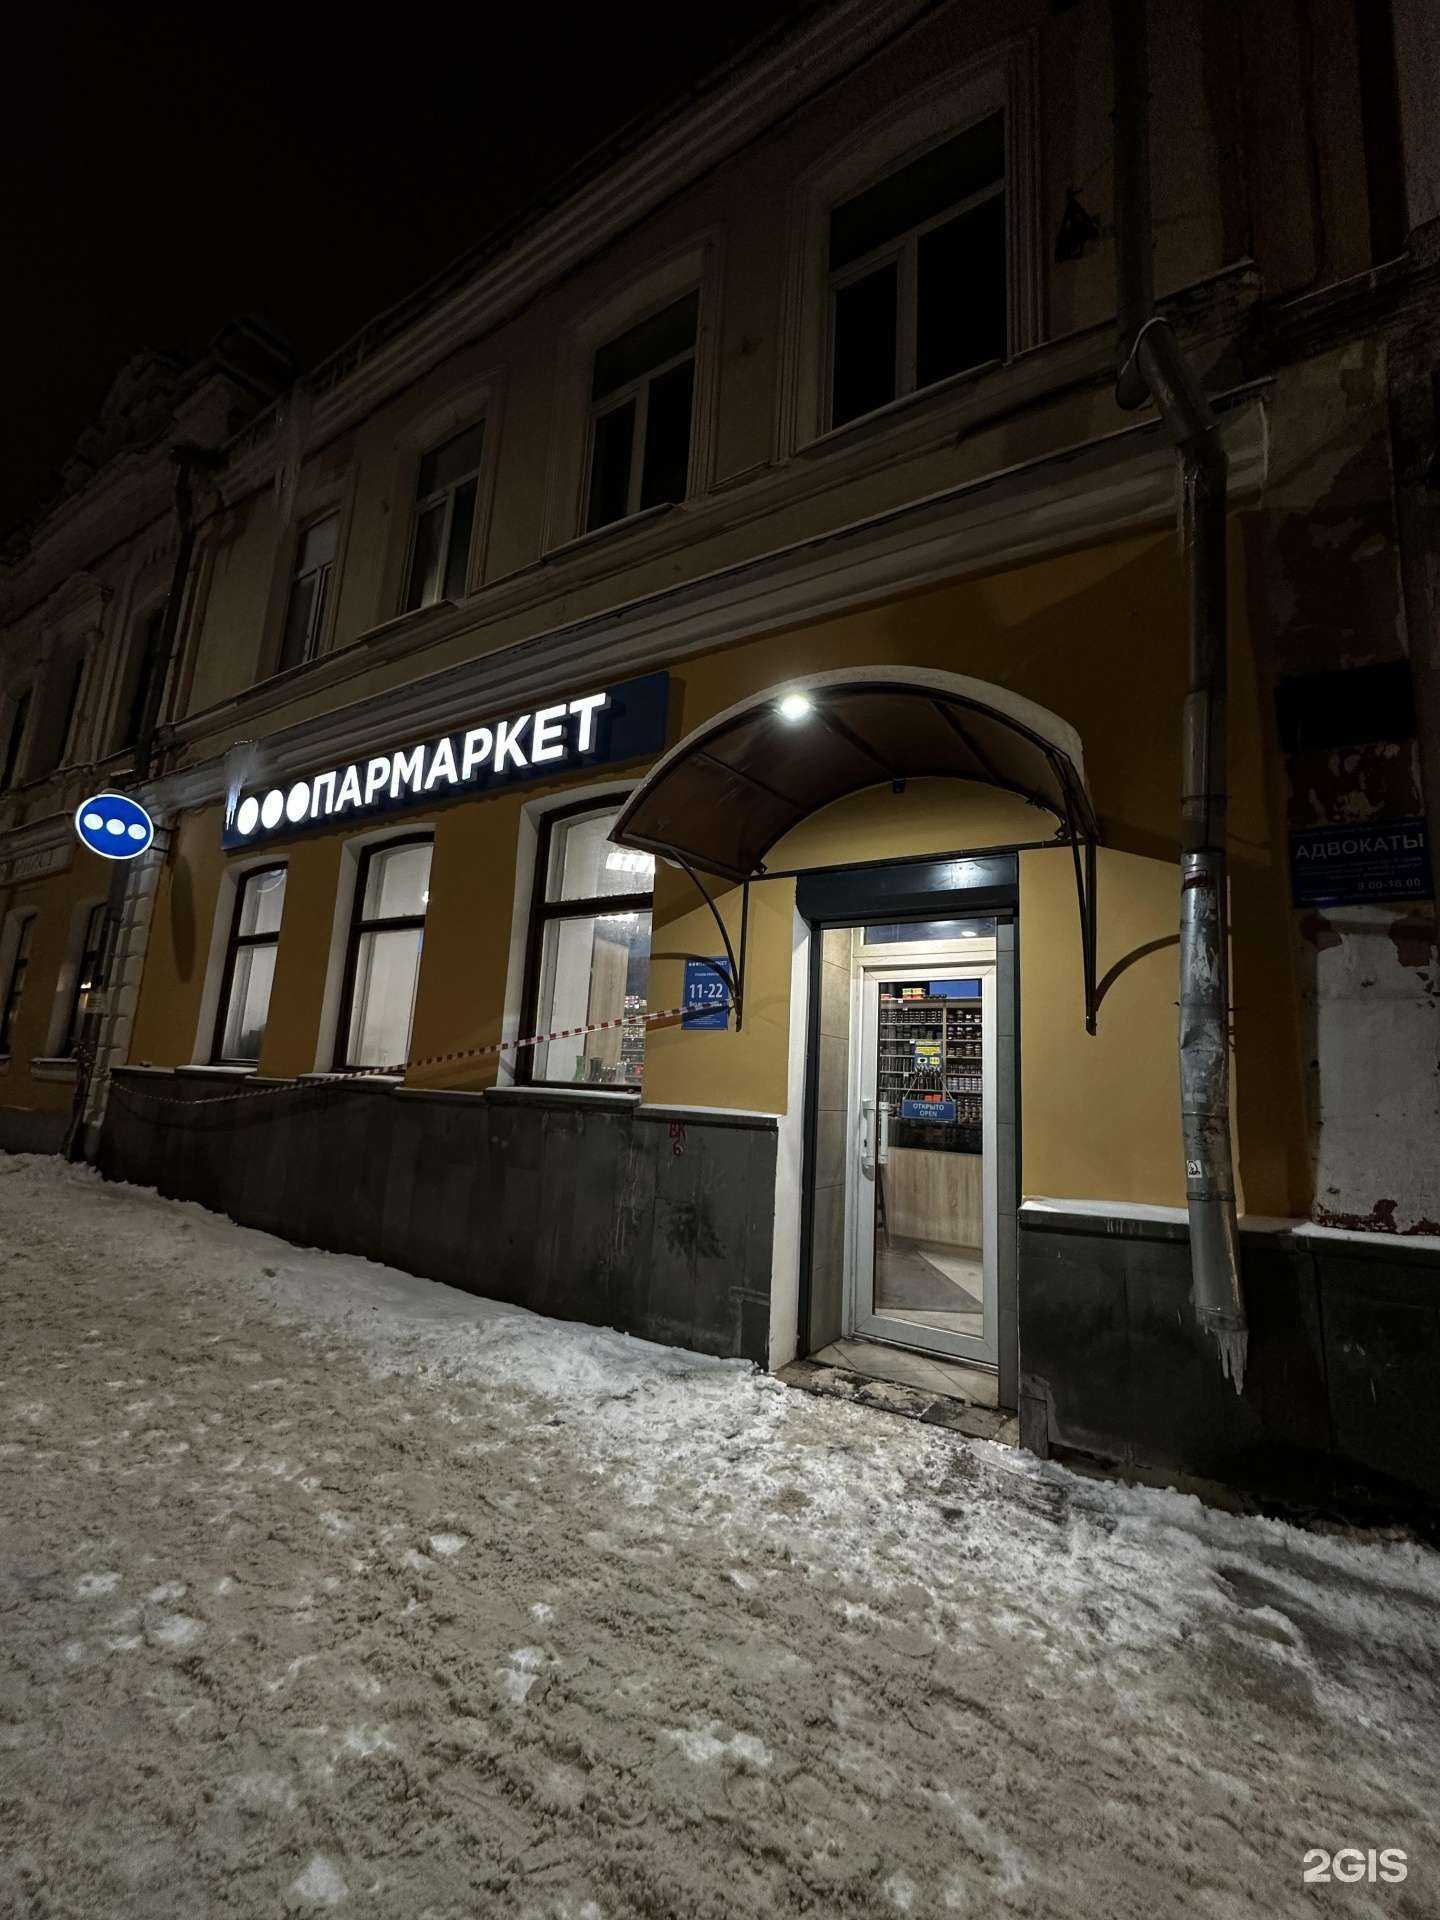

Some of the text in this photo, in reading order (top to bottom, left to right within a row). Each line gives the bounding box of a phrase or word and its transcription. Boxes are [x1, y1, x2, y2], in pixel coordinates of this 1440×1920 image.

[310, 692, 607, 818] ПАРМАРКЕТ
[1295, 832, 1425, 860] АДВОКАТЫ
[689, 983, 723, 999] 11-22
[912, 1103, 945, 1111] ОТКРЫТО
